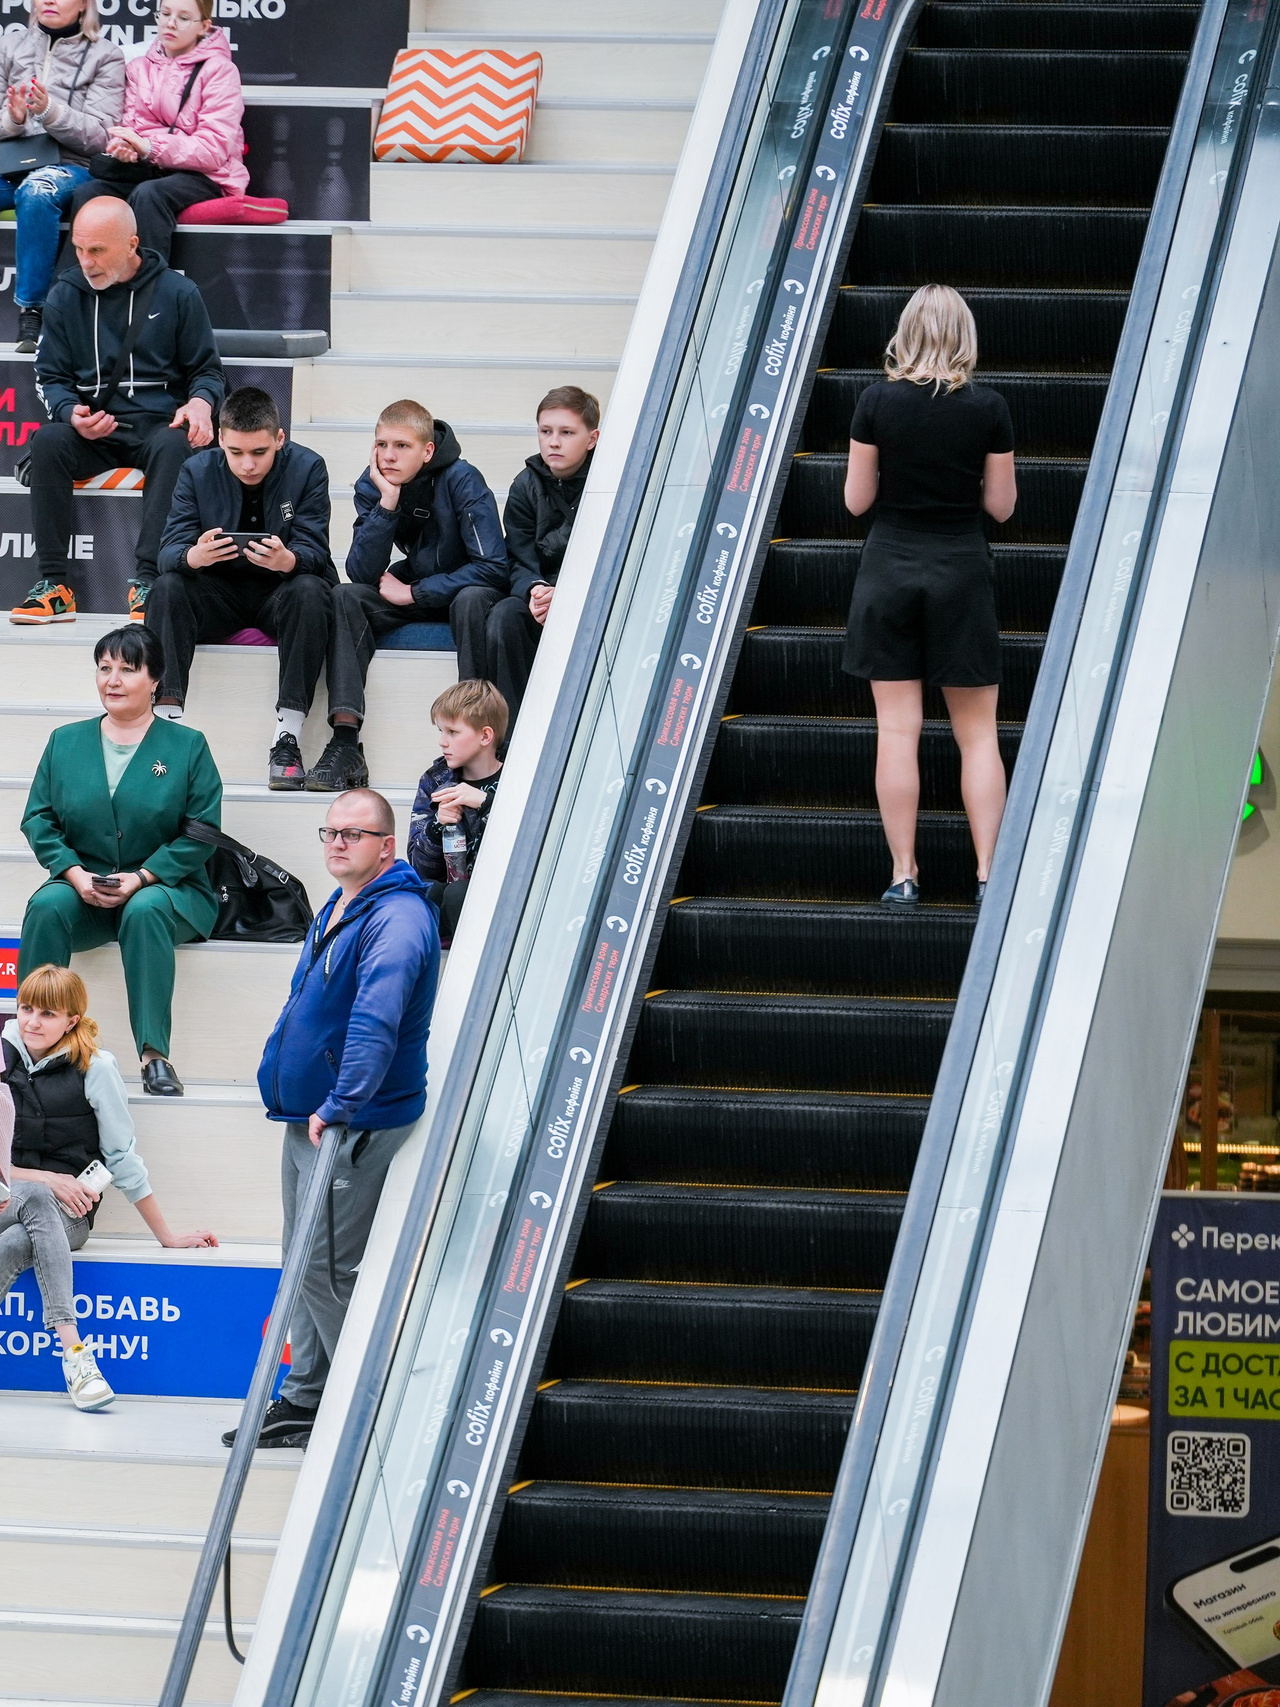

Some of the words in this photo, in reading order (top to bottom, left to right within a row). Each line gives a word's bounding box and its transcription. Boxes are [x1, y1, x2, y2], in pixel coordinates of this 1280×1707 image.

[830, 103, 852, 139] cofix
[764, 338, 787, 376] cofix
[696, 584, 720, 624] cofix
[623, 843, 647, 885] cofix
[547, 1115, 572, 1159] cofix
[71, 1293, 181, 1322] ОБАВЬ
[1175, 1277, 1280, 1304] САМОЕ
[1175, 1351, 1195, 1373] С
[1201, 1352, 1280, 1378] ДОСТ
[1174, 1385, 1208, 1408] ЗА
[1215, 1386, 1225, 1409] 1
[466, 1400, 492, 1446] cofix
